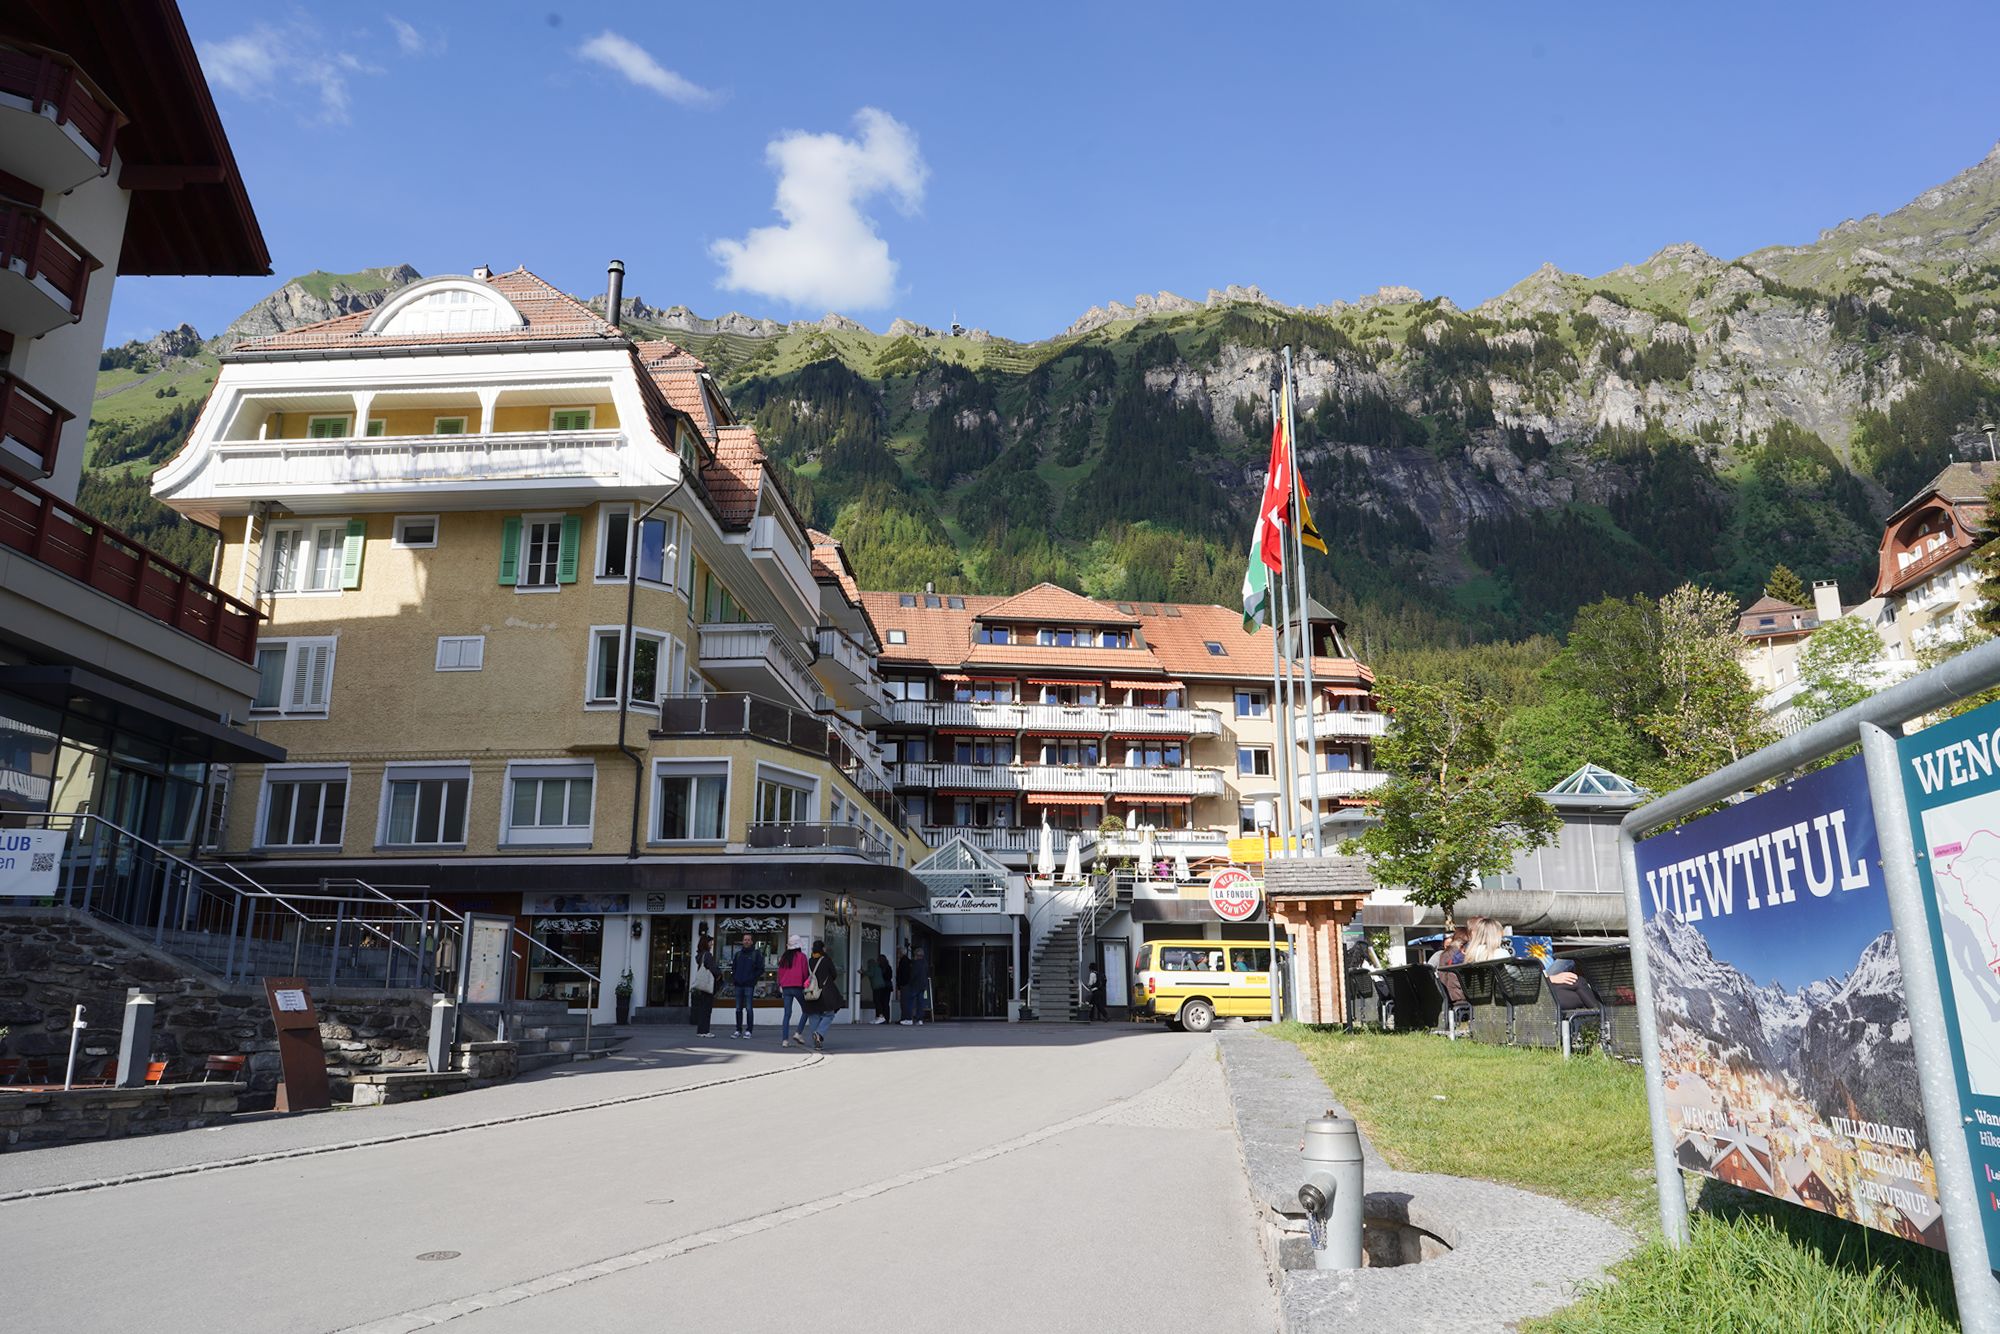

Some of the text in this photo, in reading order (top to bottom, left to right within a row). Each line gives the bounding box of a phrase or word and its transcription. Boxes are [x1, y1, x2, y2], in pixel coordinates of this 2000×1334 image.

[1646, 809, 1870, 923] VIEWTIFUL
[1218, 873, 1248, 887] WENGE
[719, 894, 802, 909] TISSOT
[1215, 890, 1253, 898] LA FONDUE
[932, 899, 999, 909] Hotel Silberhorn
[1219, 900, 1251, 914] SCHWEIZ
[1681, 1105, 1729, 1132] WENGEN
[1974, 1108, 2000, 1127] Wan
[1830, 1116, 1917, 1149] WILLKOMMEN
[1857, 1149, 1924, 1183] WELCOME
[1859, 1178, 1930, 1216] BIENVENUE
